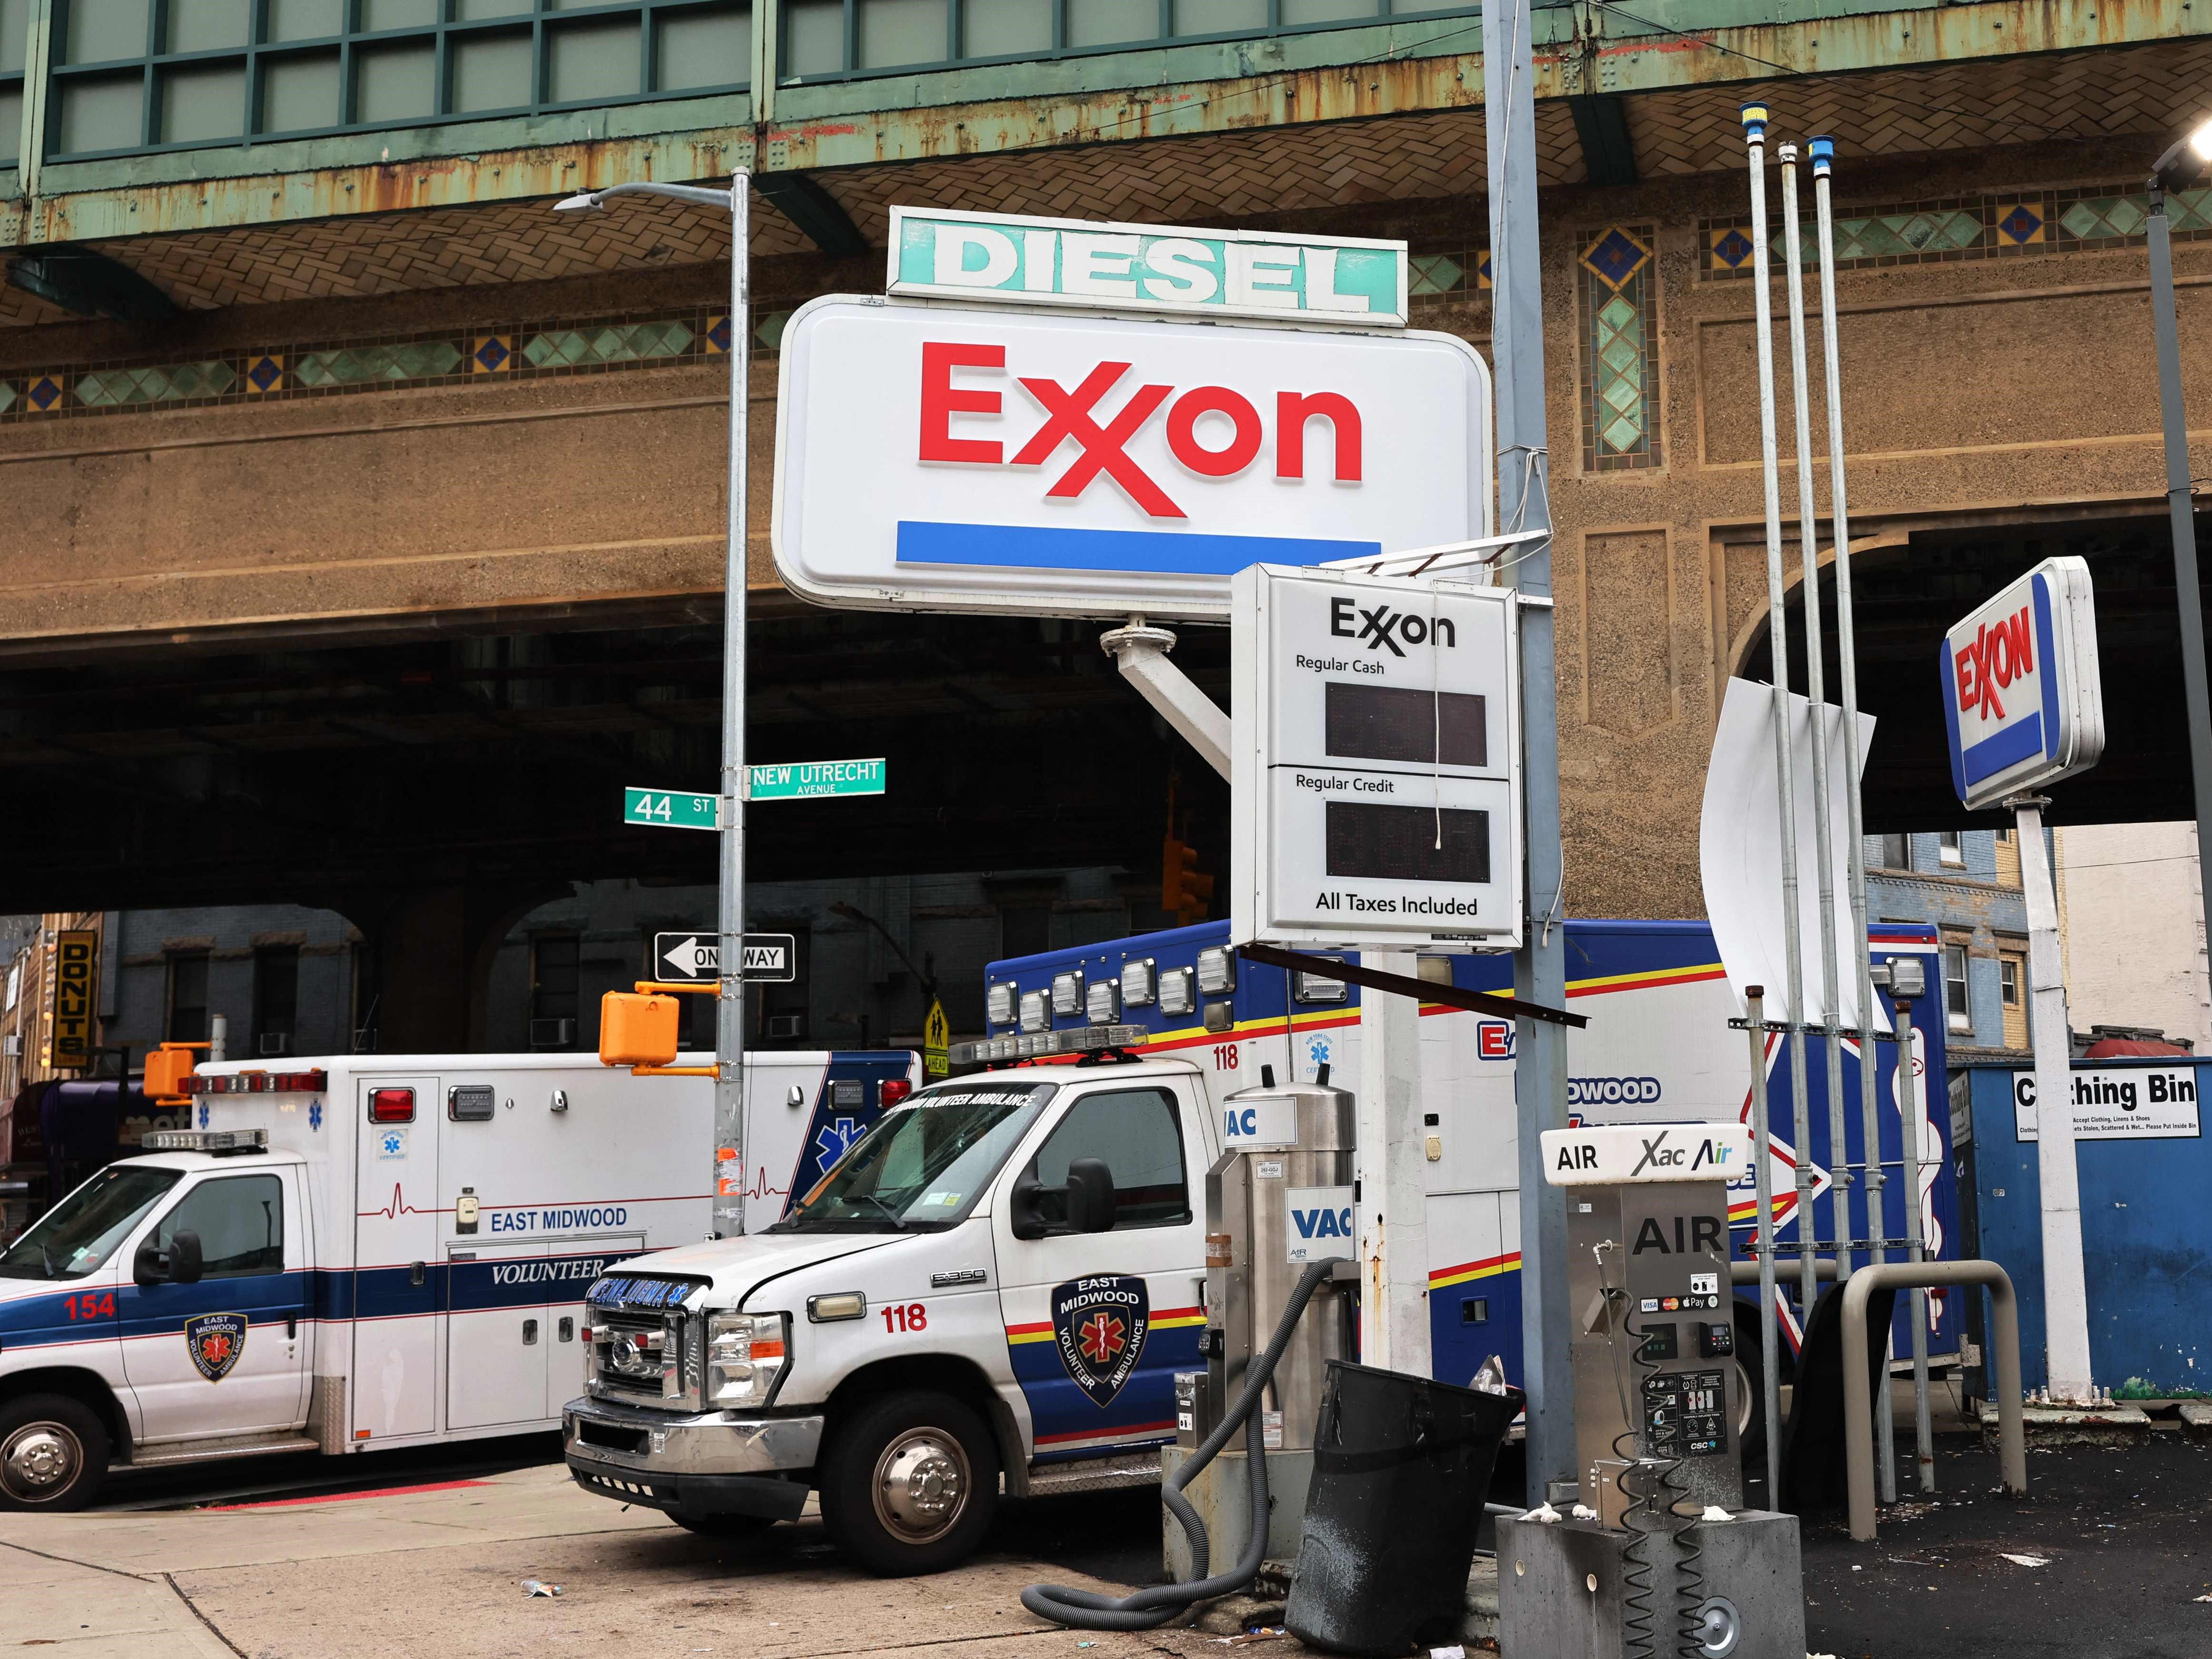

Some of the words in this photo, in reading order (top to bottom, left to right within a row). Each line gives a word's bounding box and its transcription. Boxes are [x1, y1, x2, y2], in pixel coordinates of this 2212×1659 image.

[933, 224, 1370, 313] DIESEL
[919, 341, 1362, 518] Exxon
[1331, 596, 1456, 658] Exxon
[1296, 655, 1349, 672] Regular
[1353, 660, 1384, 675] Cash
[1955, 606, 2033, 721] EXXON
[754, 767, 791, 785] NEW
[800, 762, 879, 784] UTRECHT
[1296, 774, 1349, 792] Regular
[1353, 778, 1394, 793] Credit
[797, 784, 836, 795] AVENUE
[635, 795, 672, 821] 44
[693, 798, 709, 813] ST
[1316, 892, 1339, 910] All
[1346, 894, 1396, 912] Taxes
[1402, 896, 1477, 915] Included
[695, 948, 718, 965] ON
[744, 949, 779, 966] WAY
[59, 944, 89, 1055] DONUTS
[928, 1057, 946, 1071] AHEAD
[1213, 1044, 1238, 1070] 118
[922, 1093, 973, 1108] VOLUNTEER
[968, 1093, 1037, 1107] AMBULANCE
[1567, 1081, 1658, 1101] DWOOD
[2148, 1074, 2195, 1103] Bin
[1224, 1108, 1256, 1137] AC
[1557, 1145, 1598, 1170] AIR
[1630, 1130, 1686, 1177] Xac
[1691, 1139, 1732, 1171] Air
[492, 1212, 537, 1232] EAST
[543, 1207, 627, 1230] MIDWOOD
[1291, 1207, 1352, 1239] VAC
[1632, 1215, 1725, 1256] AIR
[492, 1259, 605, 1285] VOLUNTEER
[1078, 1277, 1119, 1292] EAST
[64, 1292, 115, 1320] 154
[1060, 1291, 1139, 1314] MIDWOOD
[1691, 1298, 1704, 1308] Pay
[196, 1323, 238, 1335] MIDWOOD
[204, 1316, 228, 1325] EAST
[881, 1303, 927, 1333] 118
[189, 1339, 212, 1377] VOLUNTEER
[219, 1334, 243, 1375] AMBULANCE
[1060, 1326, 1095, 1390] VOLUNTEER
[1111, 1319, 1144, 1390] AMBULANCE
[1691, 1441, 1708, 1450] CSC
